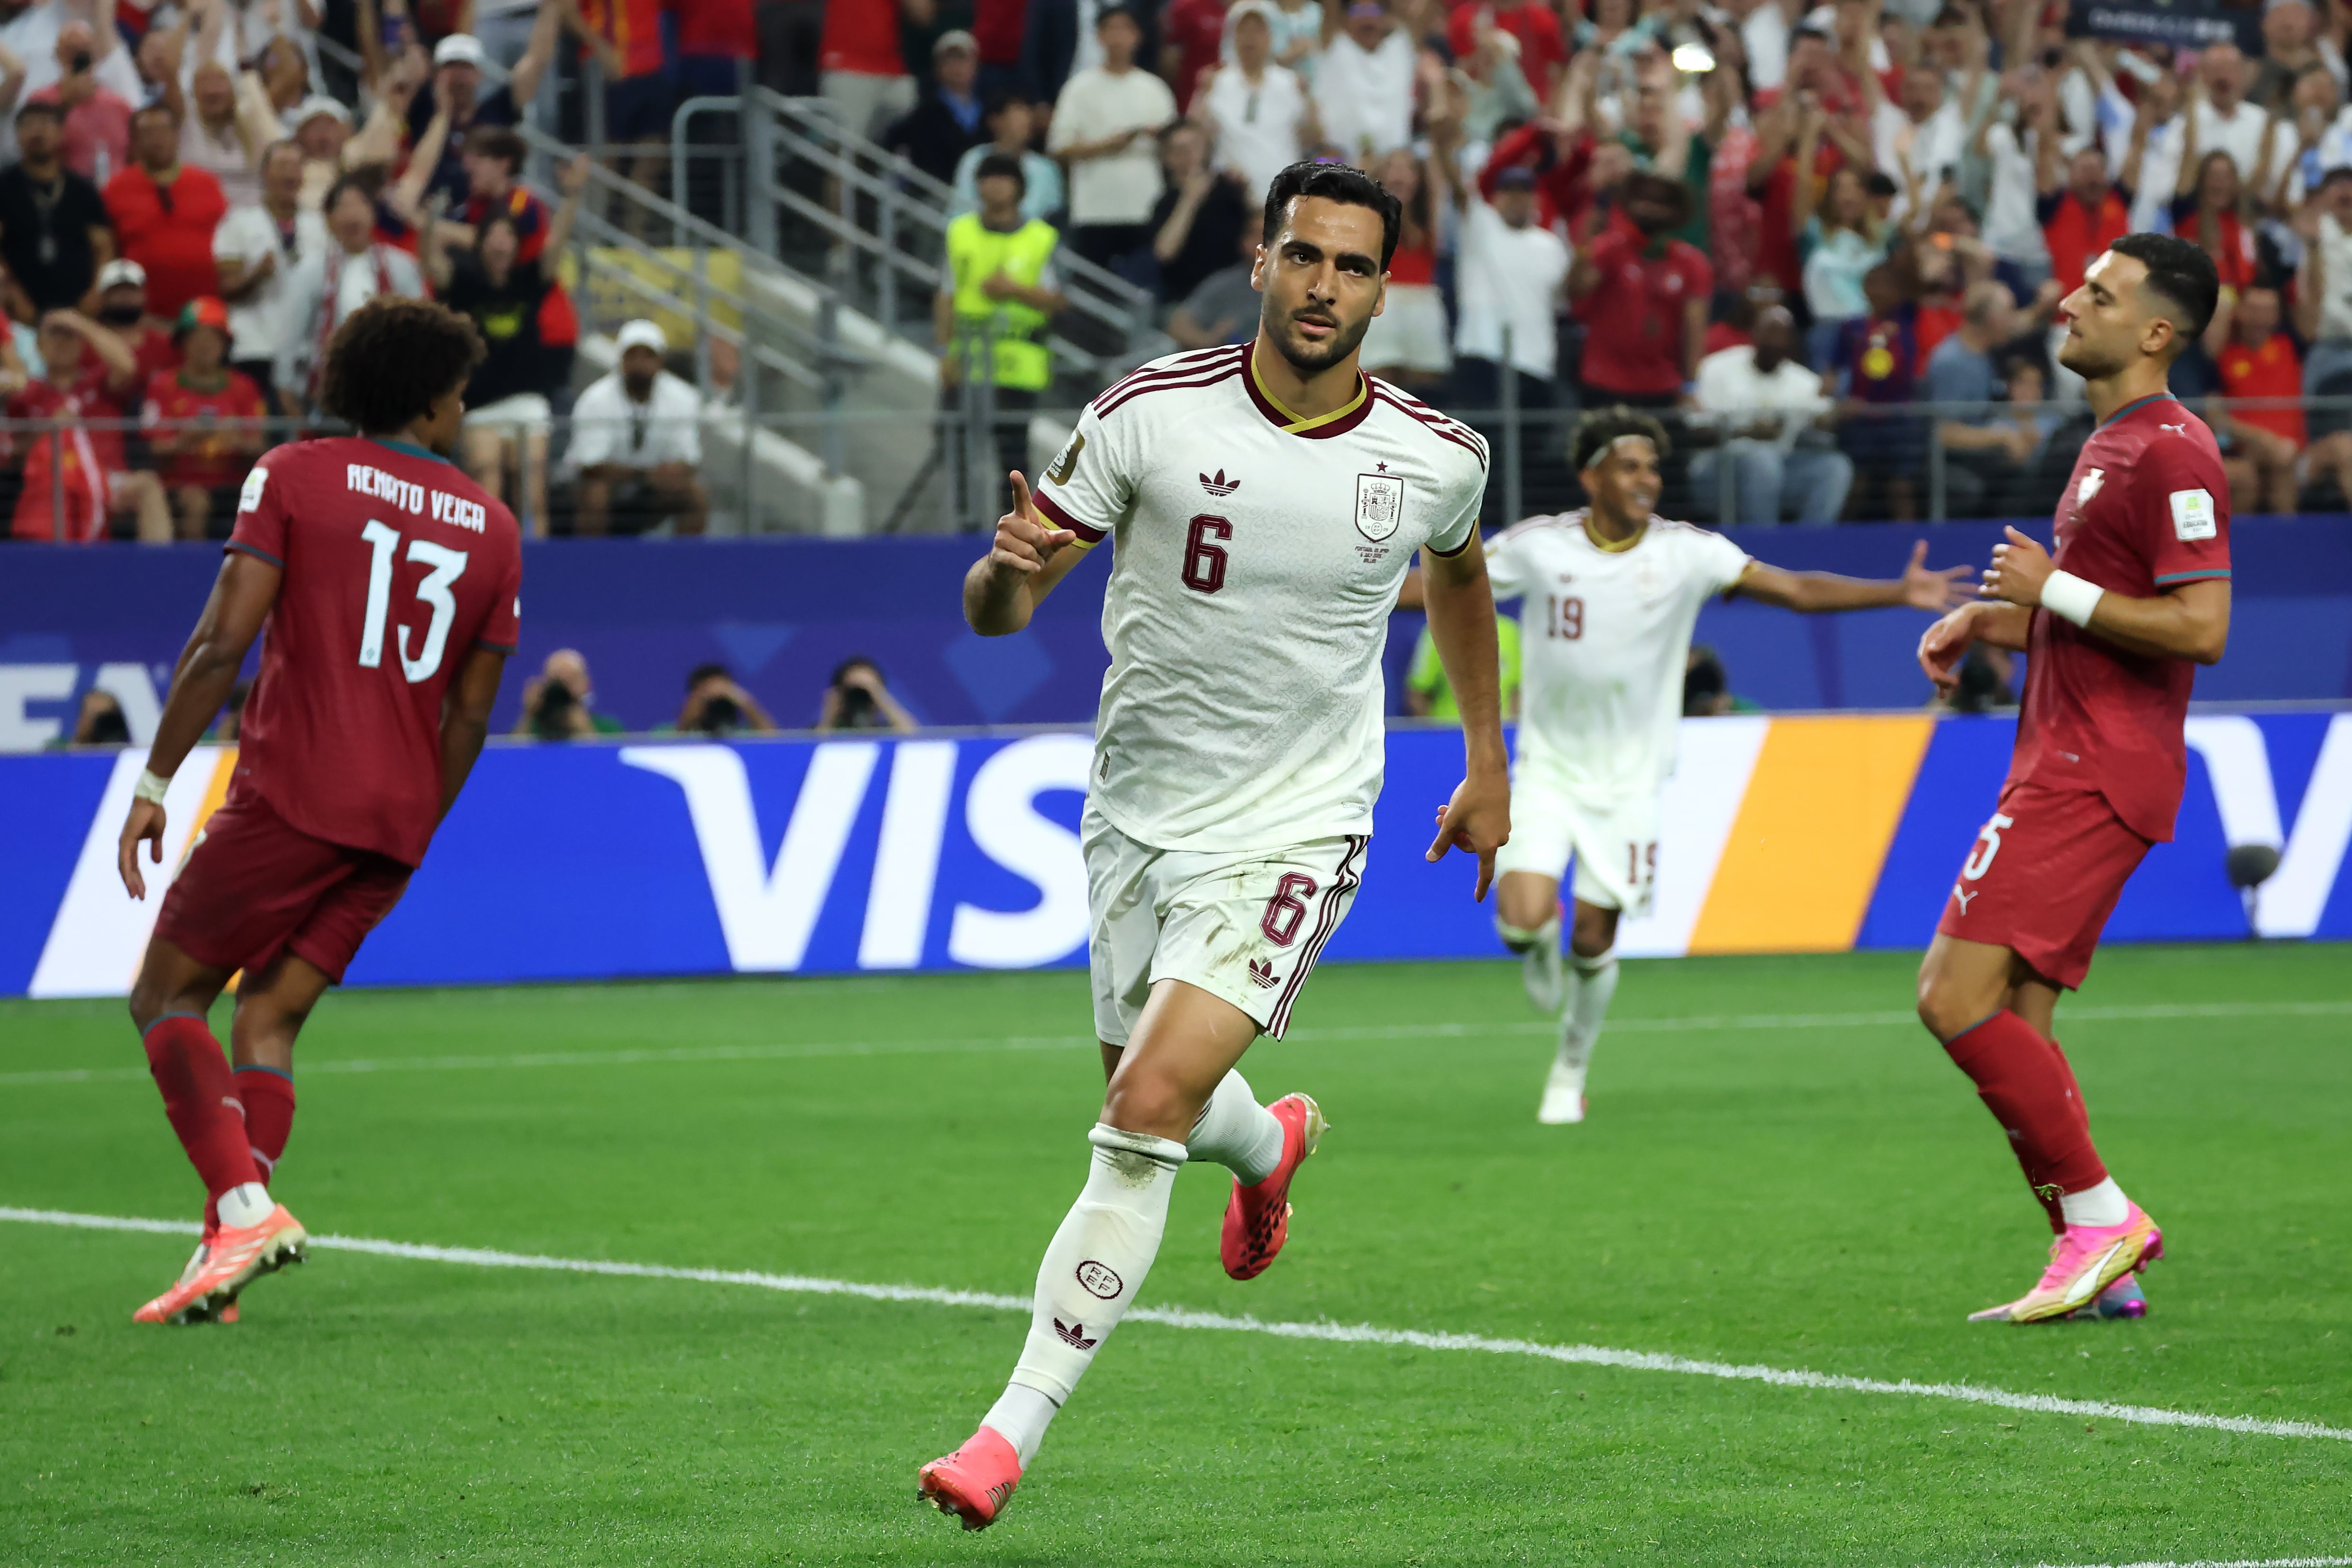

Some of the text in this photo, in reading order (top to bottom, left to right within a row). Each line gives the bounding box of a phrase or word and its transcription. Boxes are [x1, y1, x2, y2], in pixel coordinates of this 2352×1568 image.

[347, 463, 425, 515] RENATO
[1181, 514, 1232, 593] 6
[358, 519, 468, 683] 13
[1548, 595, 1584, 640] 19
[617, 733, 1096, 971] VIS
[1963, 812, 2014, 881] 5
[1259, 871, 1319, 948] 6
